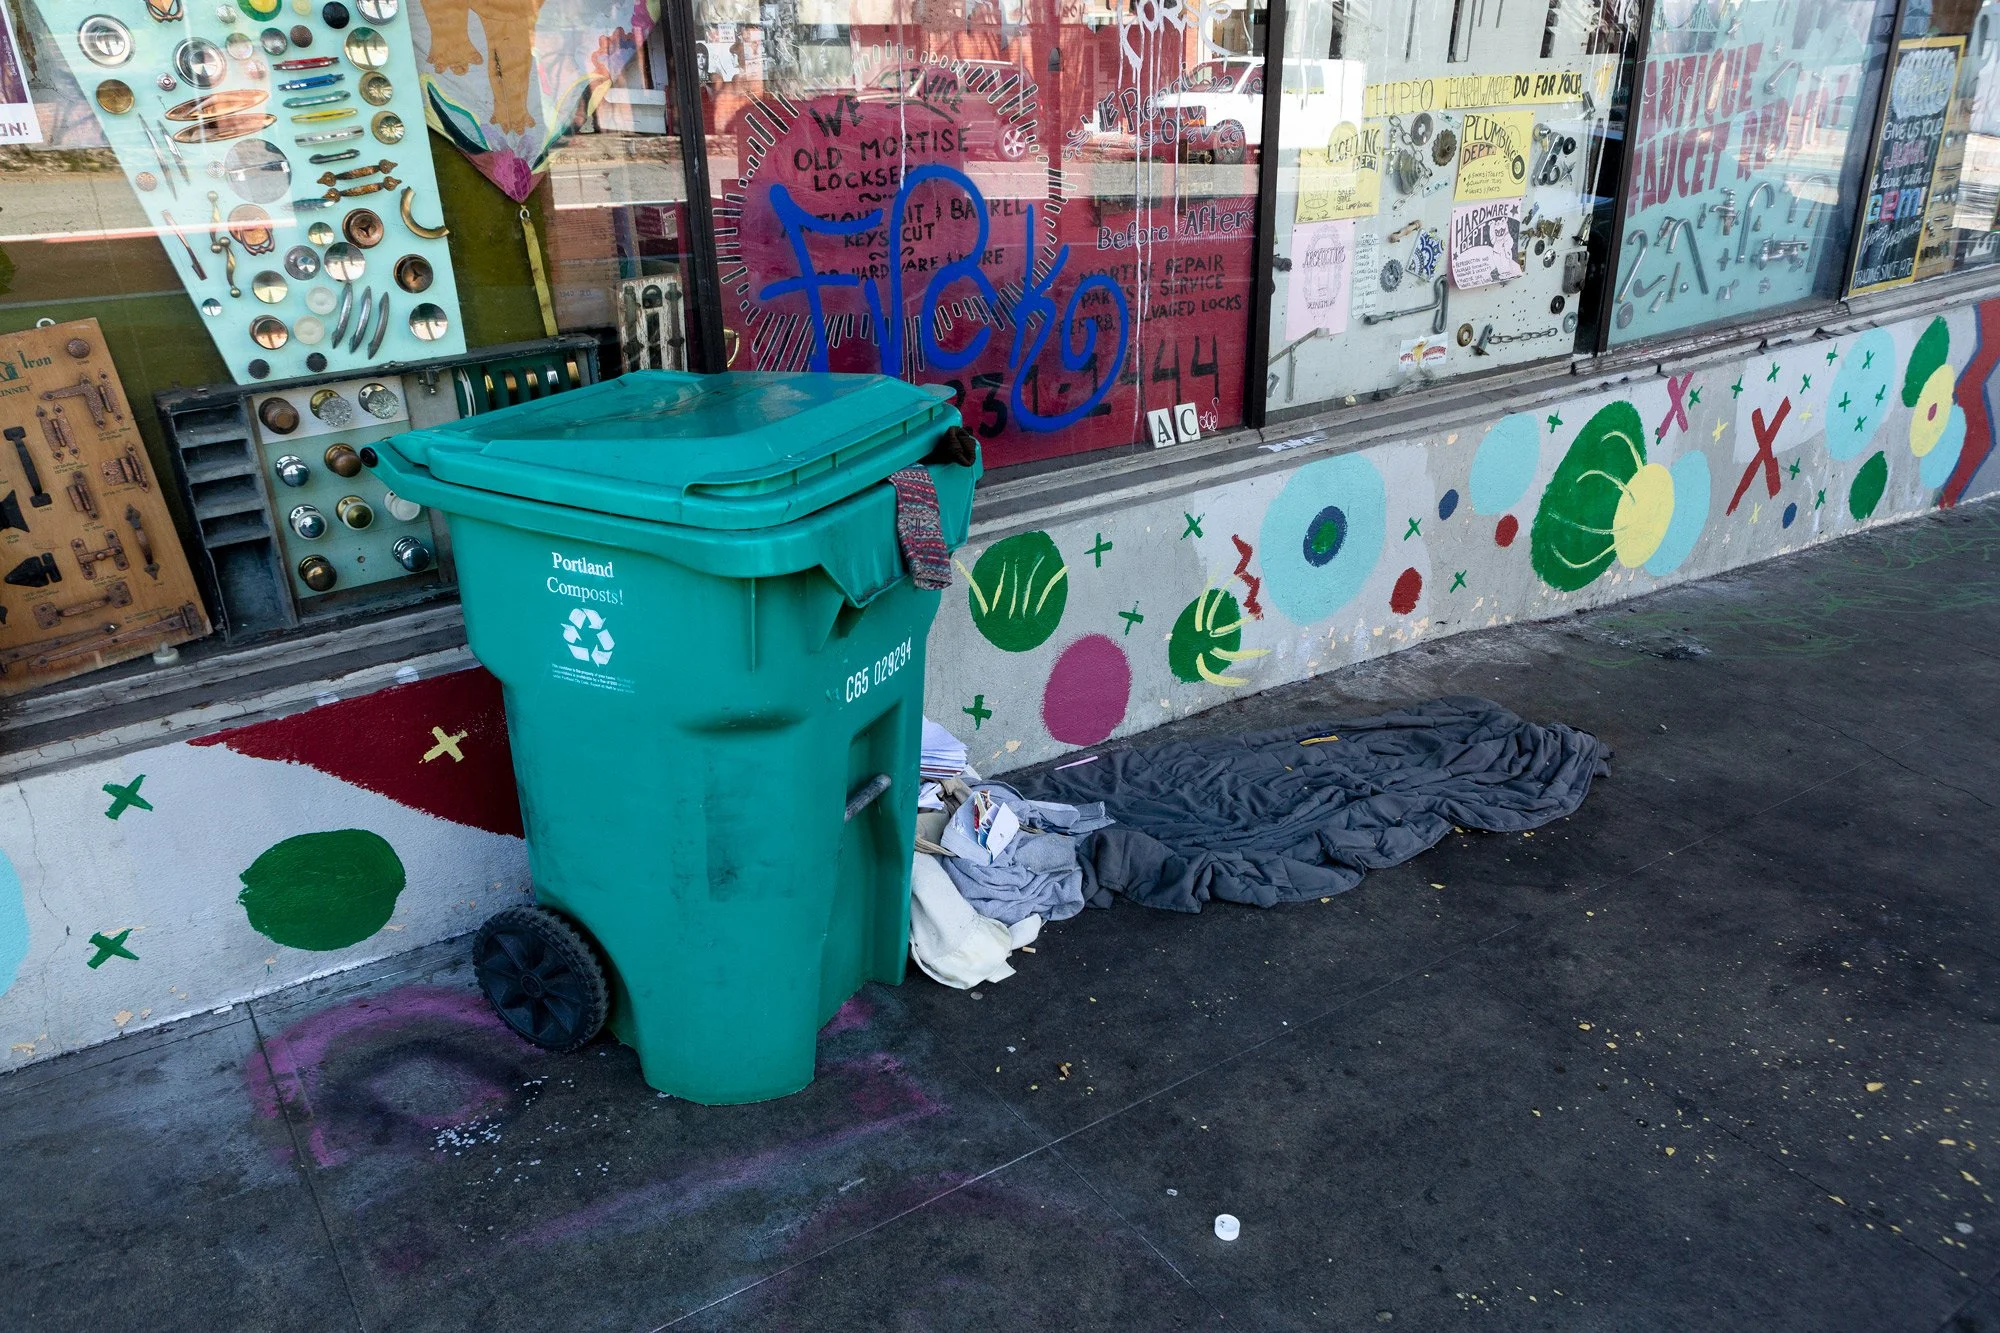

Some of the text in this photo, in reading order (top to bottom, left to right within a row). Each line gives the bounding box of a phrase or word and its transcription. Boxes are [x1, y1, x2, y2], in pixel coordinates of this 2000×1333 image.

[1513, 75, 1529, 99] DO
[1534, 74, 1554, 98] FOR
[1638, 42, 1764, 147] ANTIQUE
[809, 93, 864, 137] WE
[1463, 114, 1518, 161] PLUMBING
[1883, 121, 1906, 141] GIVE
[1907, 120, 1920, 138] US
[793, 127, 971, 172] OLD MORTISE
[1628, 121, 1731, 218] FAUCET
[950, 196, 1028, 220] BAREL
[1184, 204, 1249, 236] After
[844, 222, 936, 248] KEYS CUT
[1097, 221, 1169, 250] Before
[1455, 203, 1509, 249] HARDWARE
[852, 257, 940, 282] HARDARE
[1165, 254, 1225, 276] REPAIR
[1160, 274, 1226, 297] SERVICE
[1201, 294, 1242, 314] LOCKS
[551, 551, 614, 578] Portland
[546, 576, 624, 606] Composts!
[846, 636, 911, 703] C65 029294
